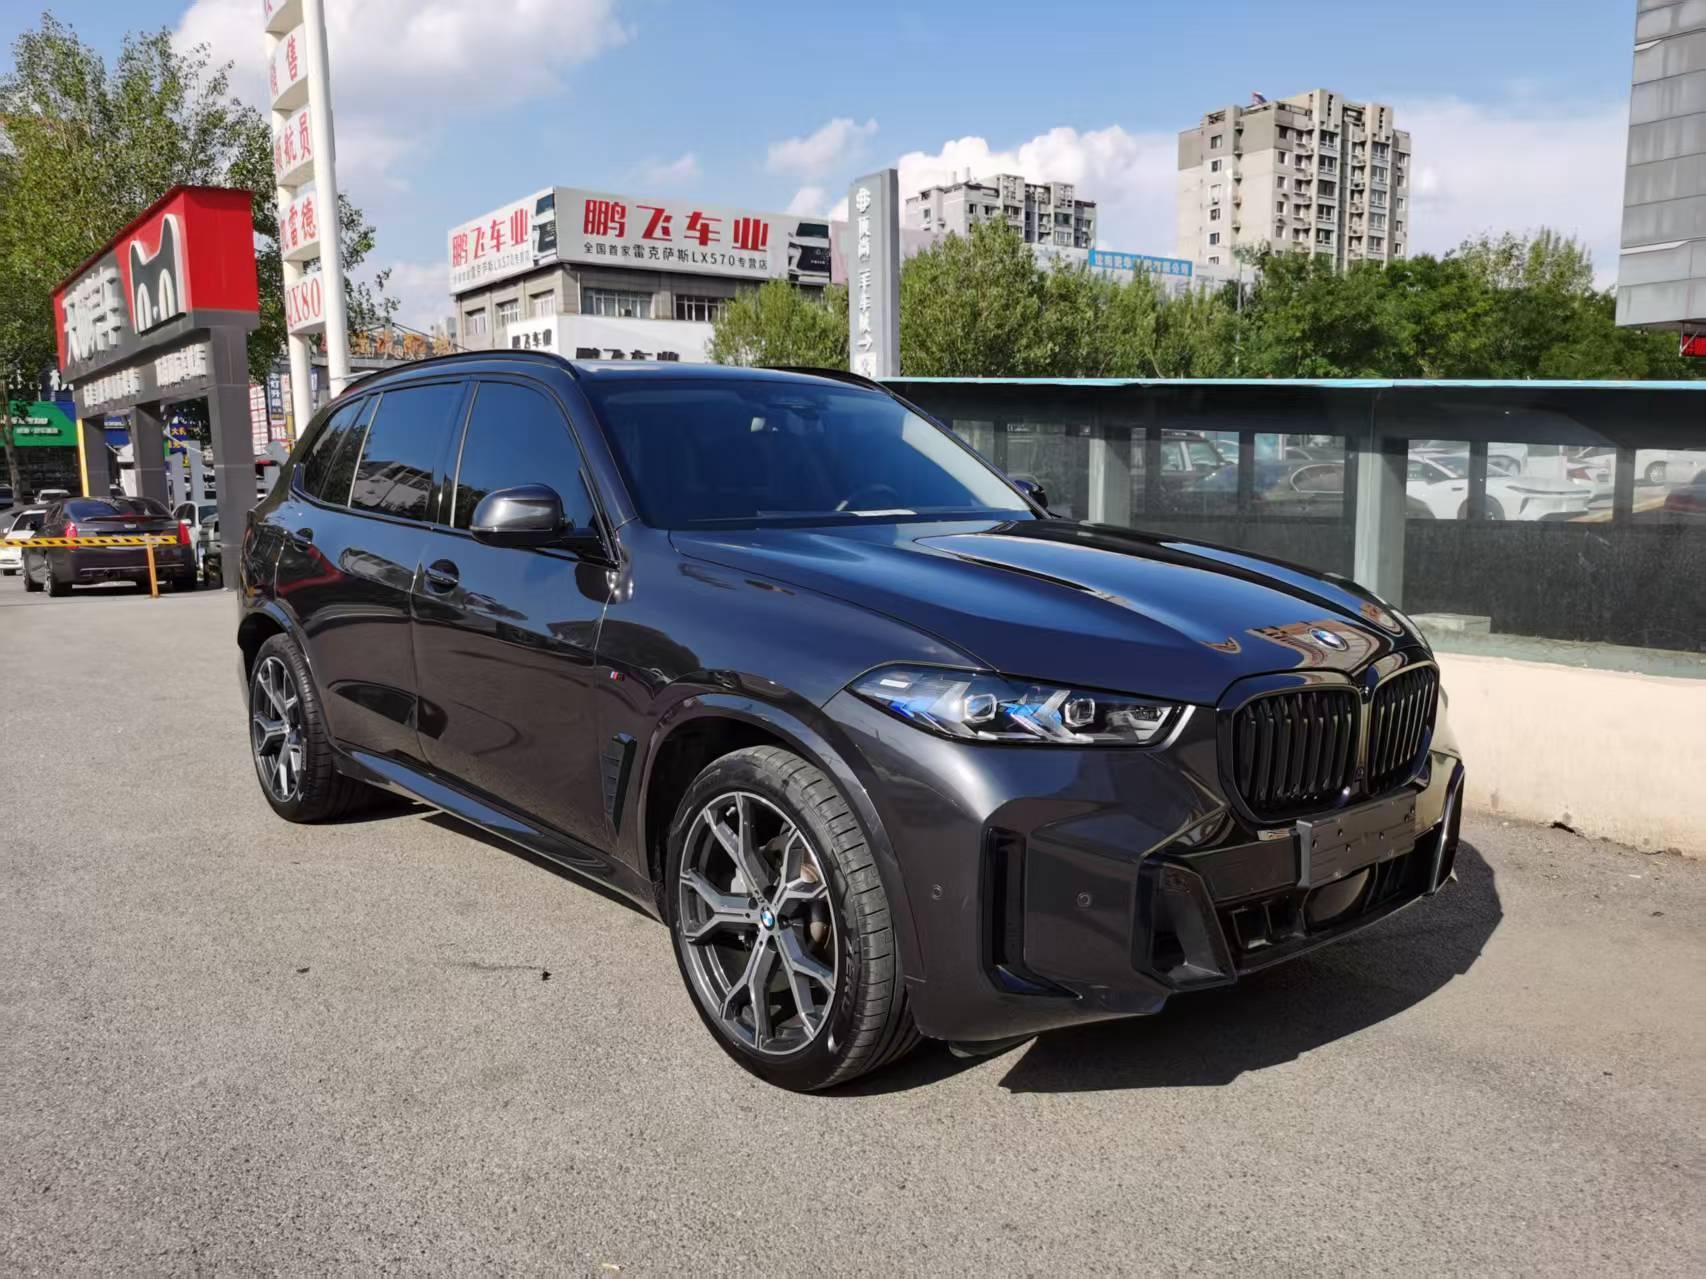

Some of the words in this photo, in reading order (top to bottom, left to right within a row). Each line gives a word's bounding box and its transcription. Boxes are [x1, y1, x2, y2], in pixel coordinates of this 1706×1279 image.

[452, 208, 528, 267] 鹏飞车业
[583, 199, 769, 252] 鹏飞车业
[584, 241, 768, 270] 全国首家雷克萨斯LX570专营店
[286, 278, 321, 327] QX80
